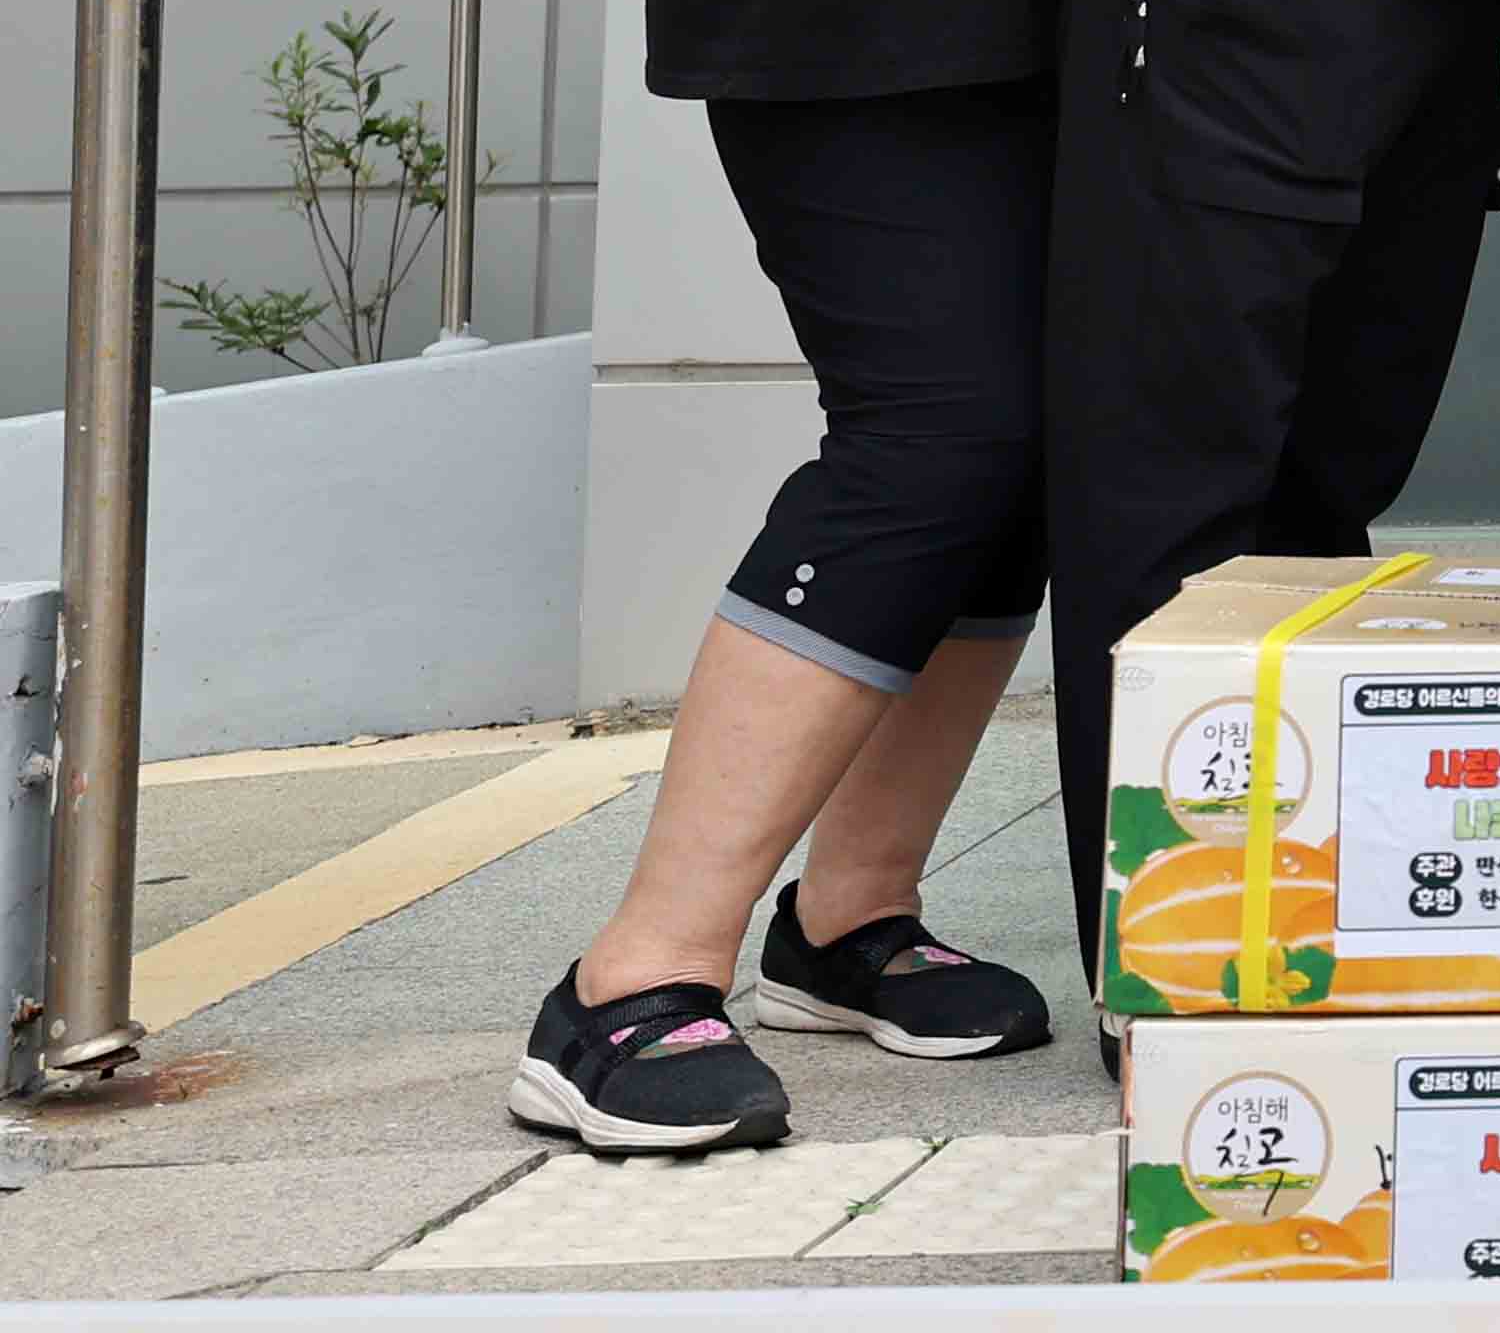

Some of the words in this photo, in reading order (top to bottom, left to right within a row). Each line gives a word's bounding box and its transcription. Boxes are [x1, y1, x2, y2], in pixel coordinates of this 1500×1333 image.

[1415, 856, 1456, 875] 주관
[1415, 890, 1456, 912] 후원
[1217, 1095, 1289, 1125] 아침해
